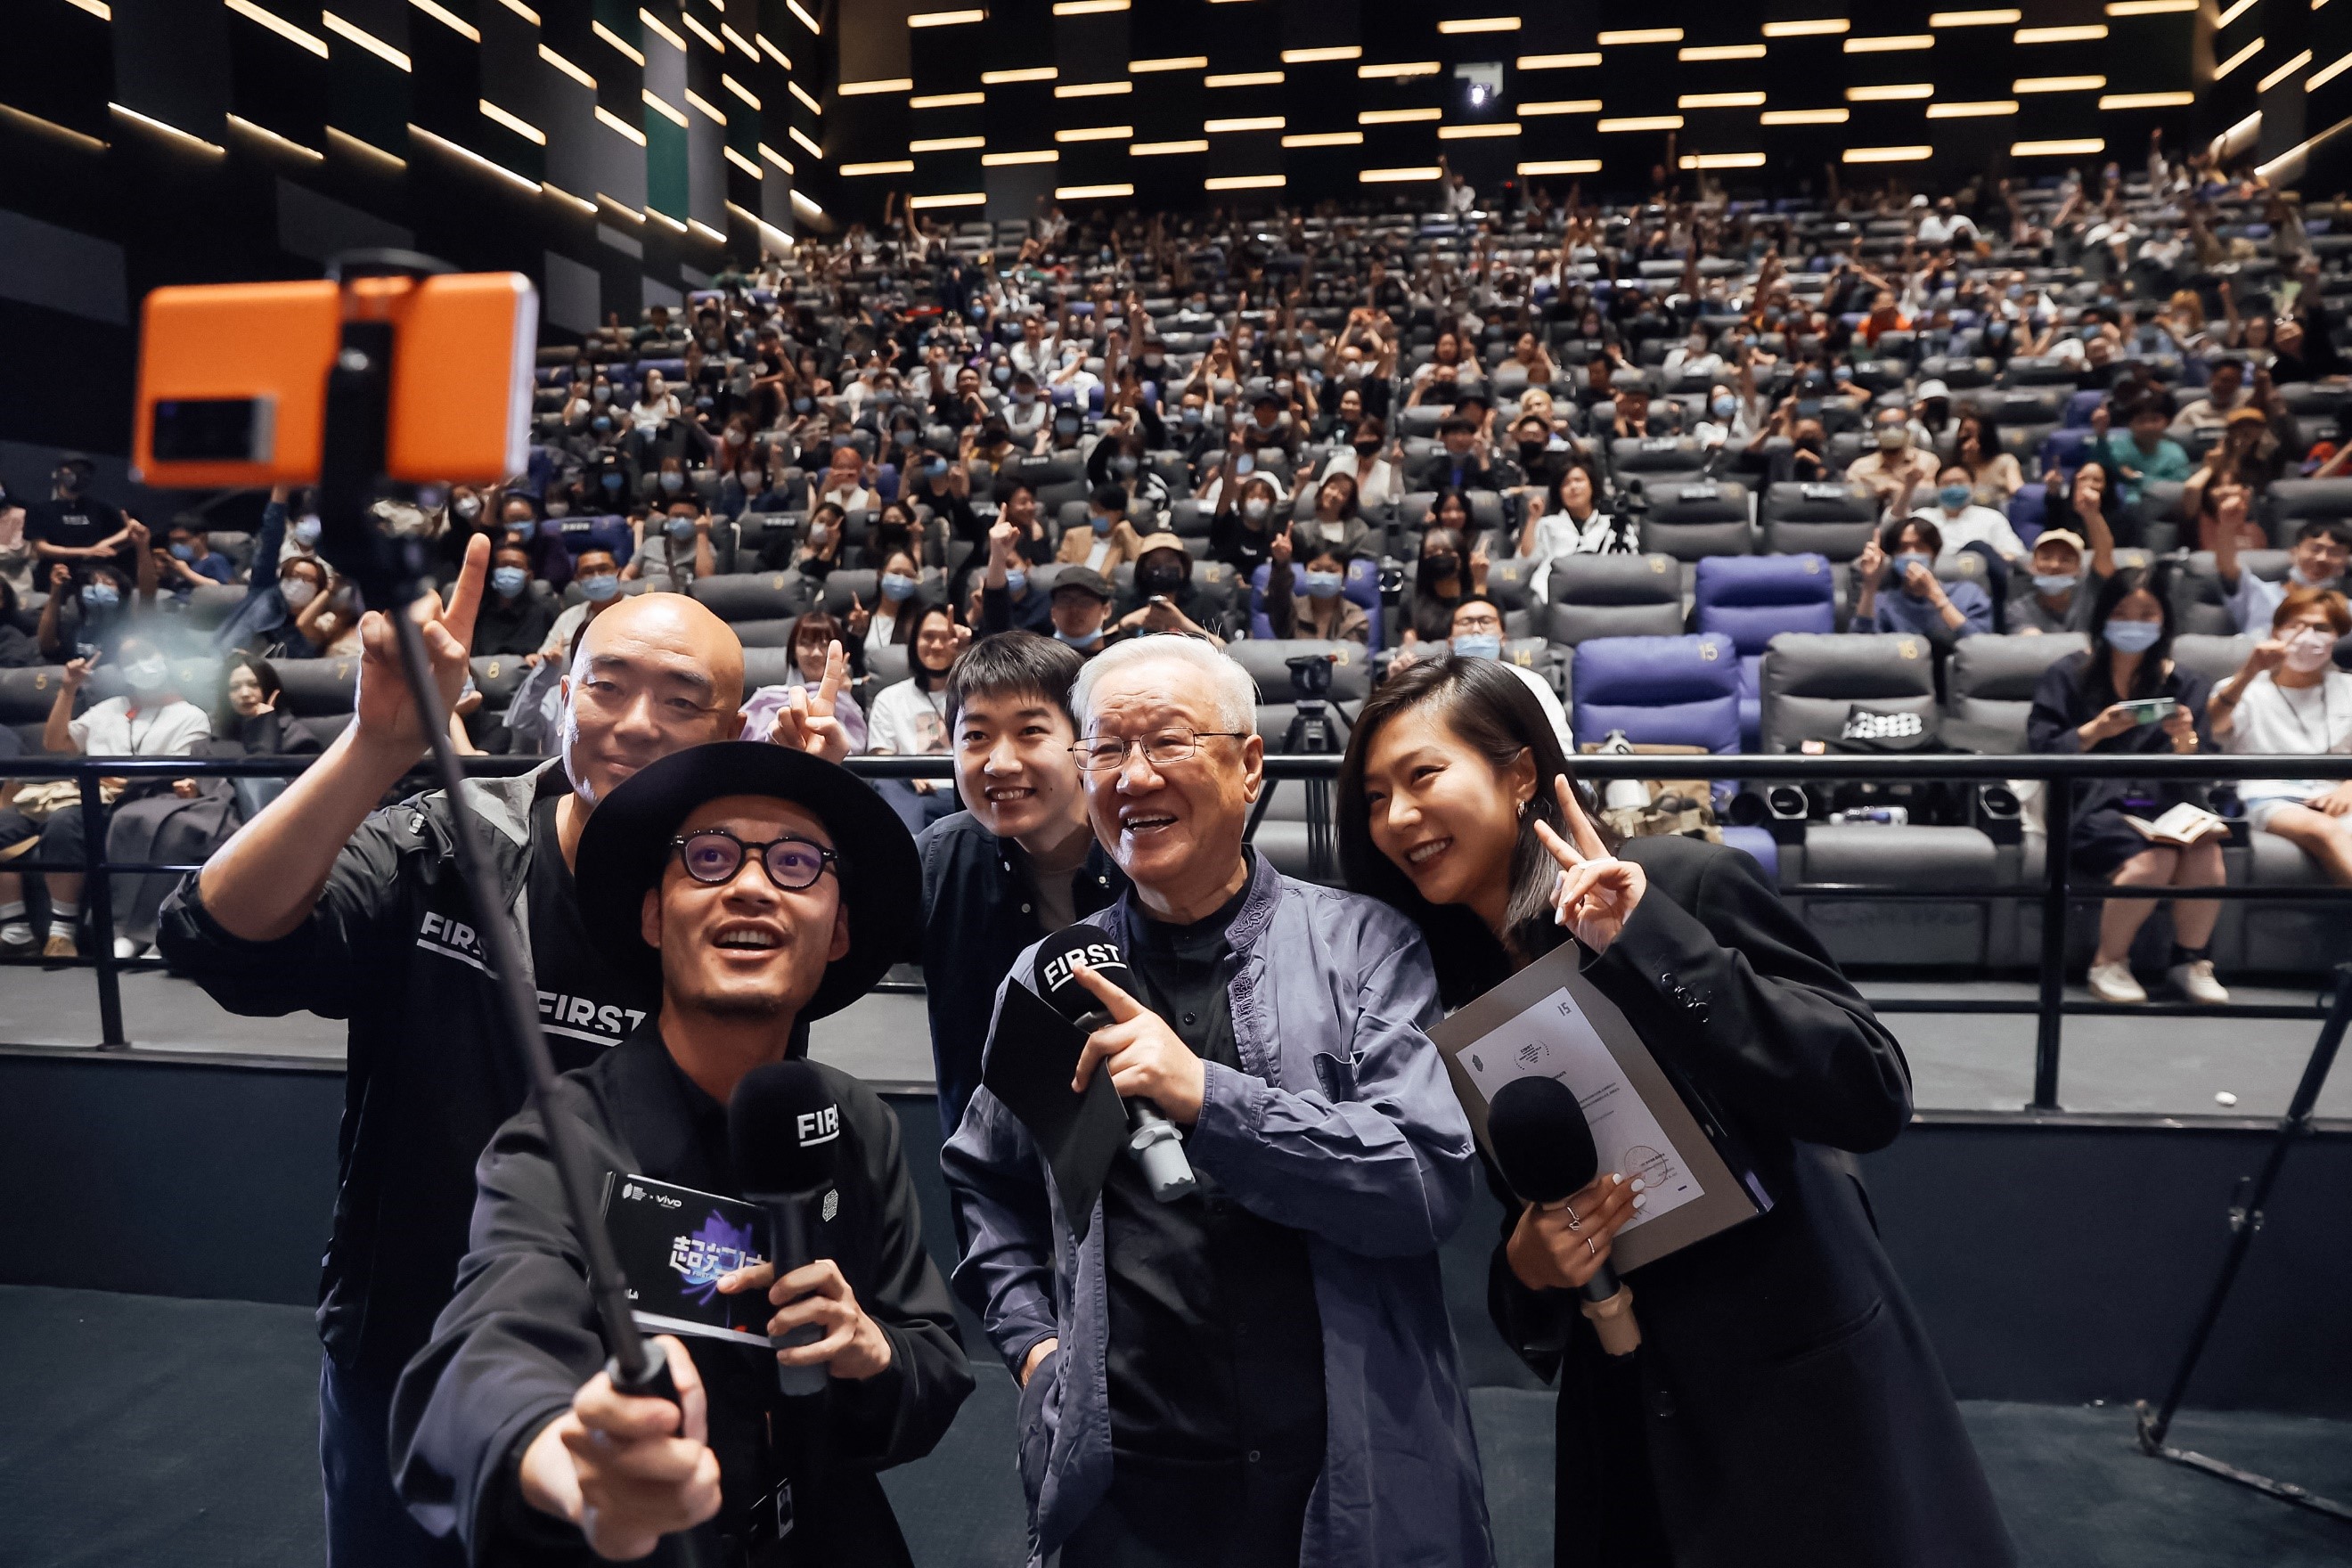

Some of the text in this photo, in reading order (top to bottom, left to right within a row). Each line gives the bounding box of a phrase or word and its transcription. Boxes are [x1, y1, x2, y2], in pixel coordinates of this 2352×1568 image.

[1514, 649, 1532, 666] 14
[1699, 641, 1719, 661] 15
[336, 664, 349, 680] 7
[487, 661, 500, 678] 8
[36, 673, 47, 690] 5
[421, 911, 486, 960] FIR
[1043, 943, 1120, 985] FIRST
[536, 990, 647, 1033] FIRST
[1557, 1002, 1572, 1017] 15
[797, 1103, 839, 1139] FIR
[656, 1195, 682, 1208] vivo
